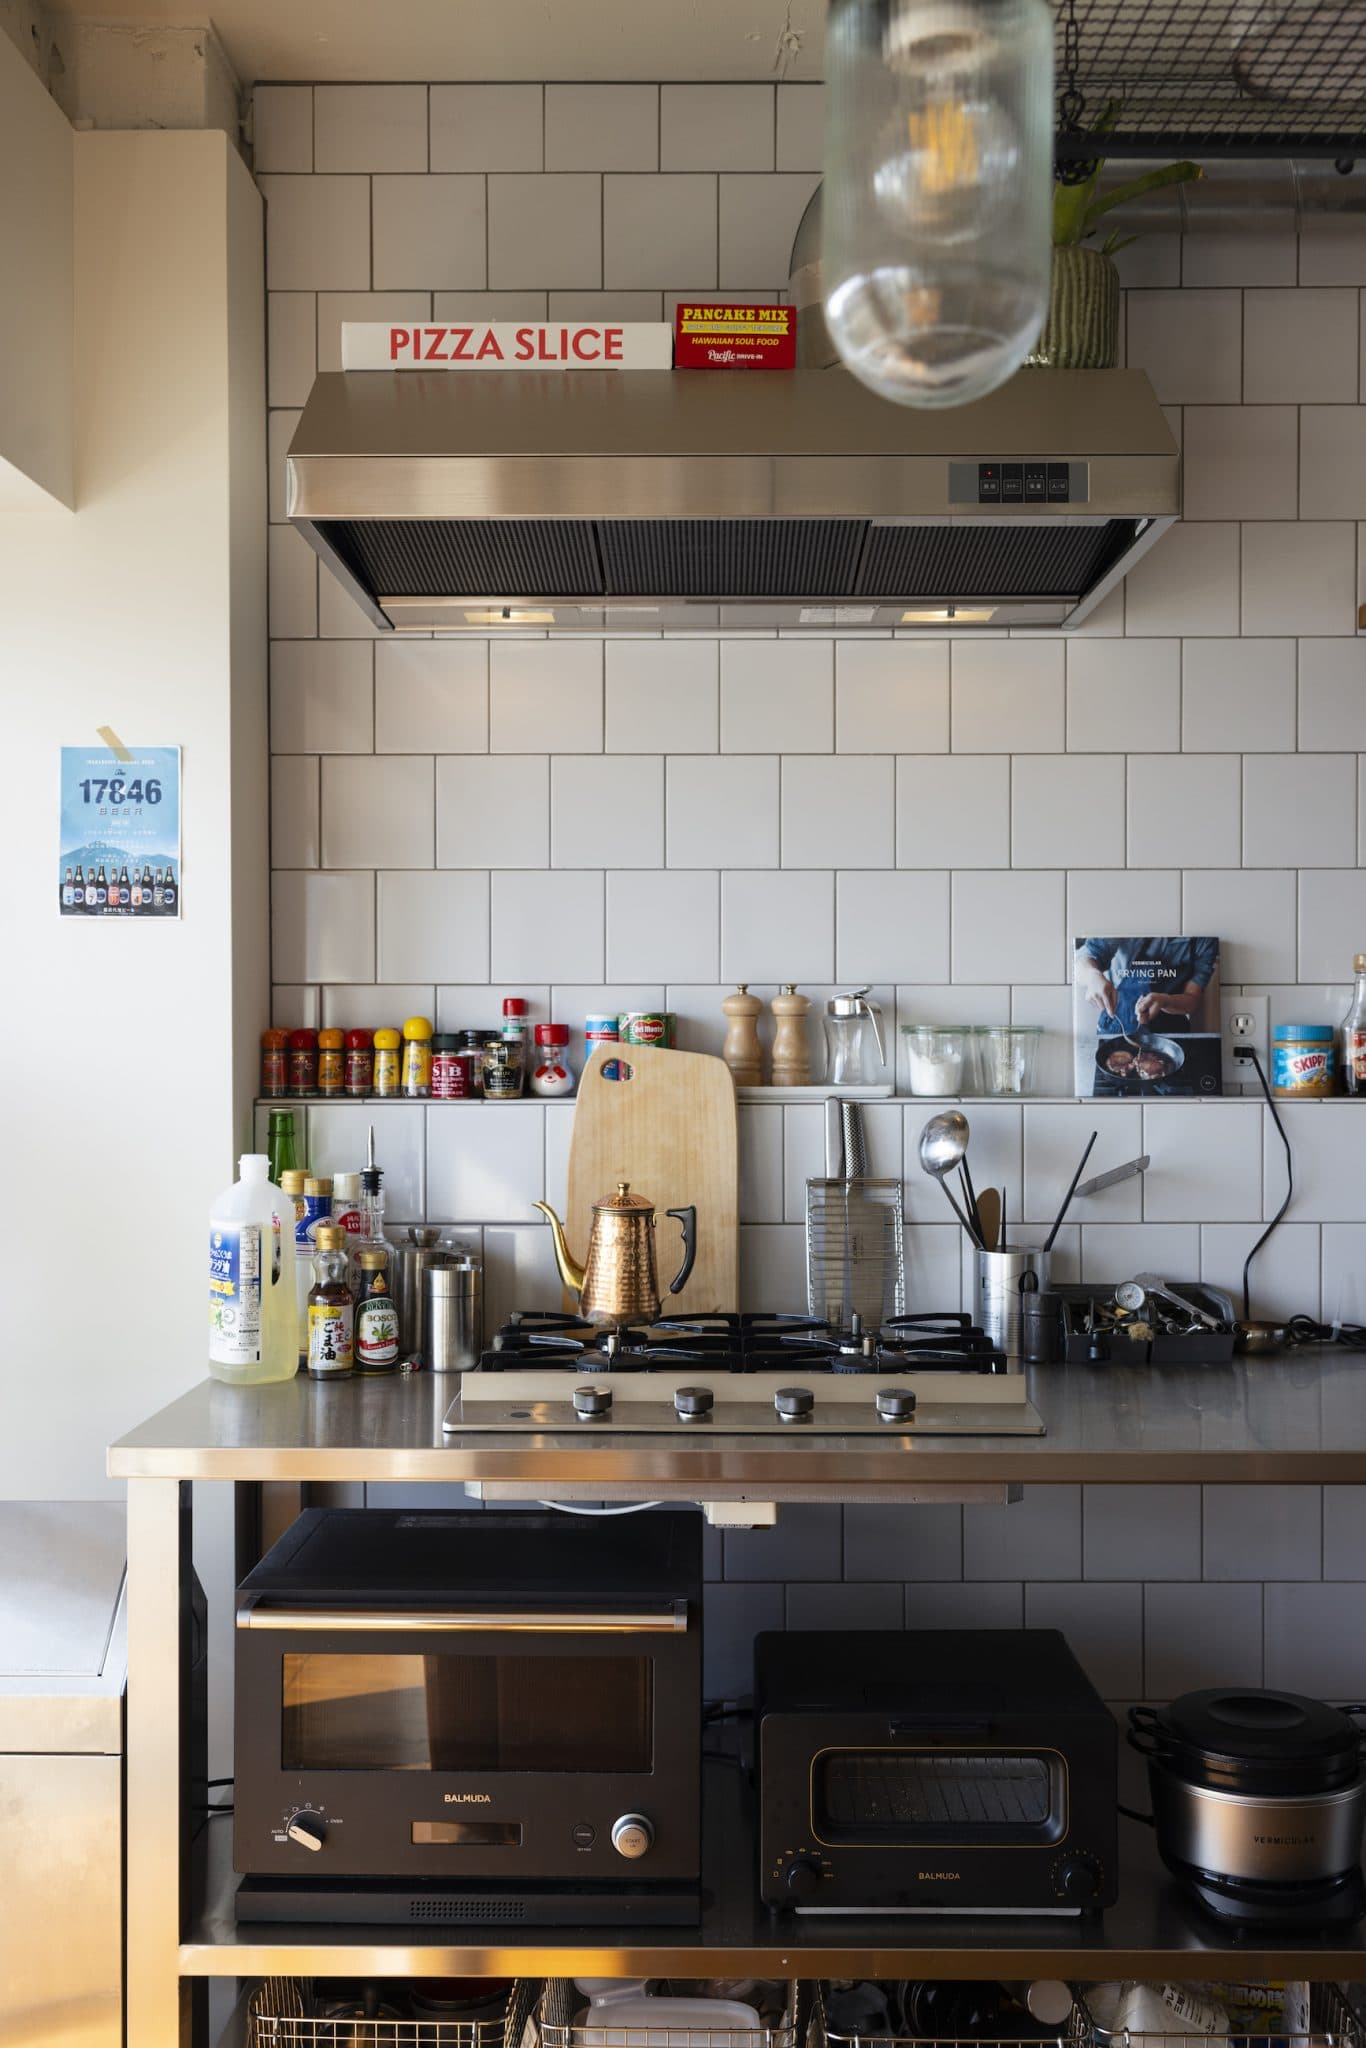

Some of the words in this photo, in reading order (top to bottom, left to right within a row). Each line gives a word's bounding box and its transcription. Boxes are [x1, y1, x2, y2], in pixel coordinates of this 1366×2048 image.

[683, 308, 755, 320] PANCAKE
[758, 310, 788, 321] MIX
[390, 328, 504, 360] PIZZA
[514, 328, 624, 360] SLICE
[692, 337, 734, 345] HAWAIIAN
[756, 338, 779, 346] FOOD
[707, 349, 736, 363] Pacific
[79, 779, 162, 804] 17846
[99, 807, 143, 815] BEER
[1118, 968, 1155, 978] FRYING
[1157, 968, 1177, 978] PAN
[320, 1321, 337, 1361] ごま油
[444, 1794, 491, 1803] BALMUDA
[918, 1872, 961, 1880] BALMUDA
